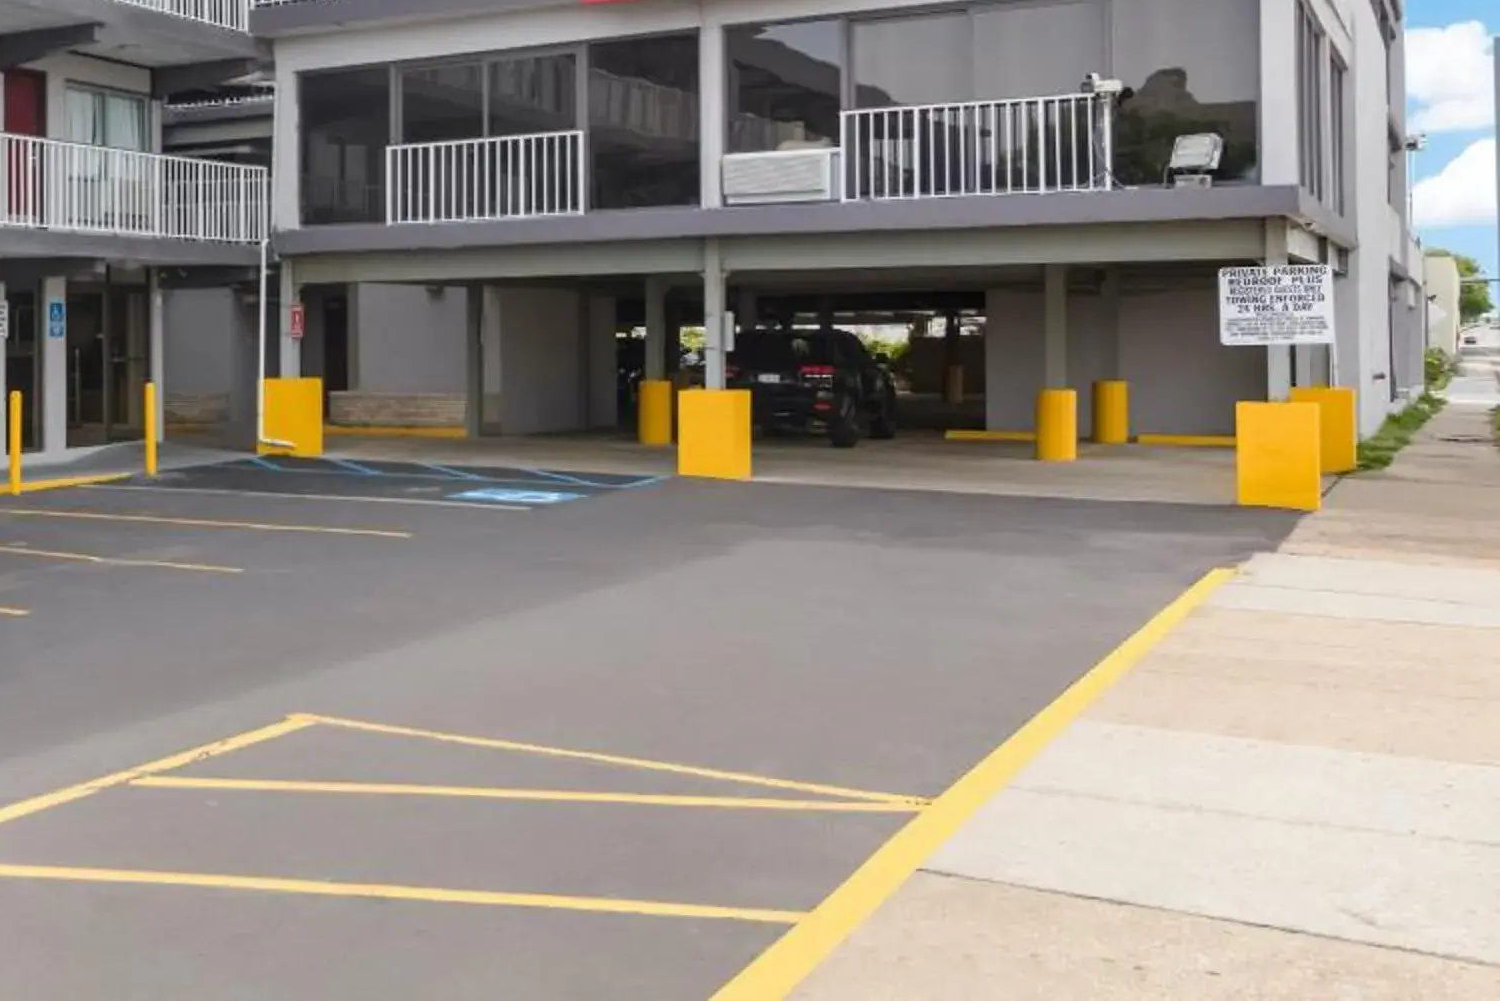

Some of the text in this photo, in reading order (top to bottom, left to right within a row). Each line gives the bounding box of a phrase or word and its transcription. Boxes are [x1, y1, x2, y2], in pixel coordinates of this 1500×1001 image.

[1221, 266, 1328, 278] PRIVATE PARKING
[1291, 275, 1323, 284] PLUS
[1226, 293, 1325, 305] TOWING ENFORCED
[1281, 302, 1289, 312] A
[1292, 302, 1314, 312] DAY
